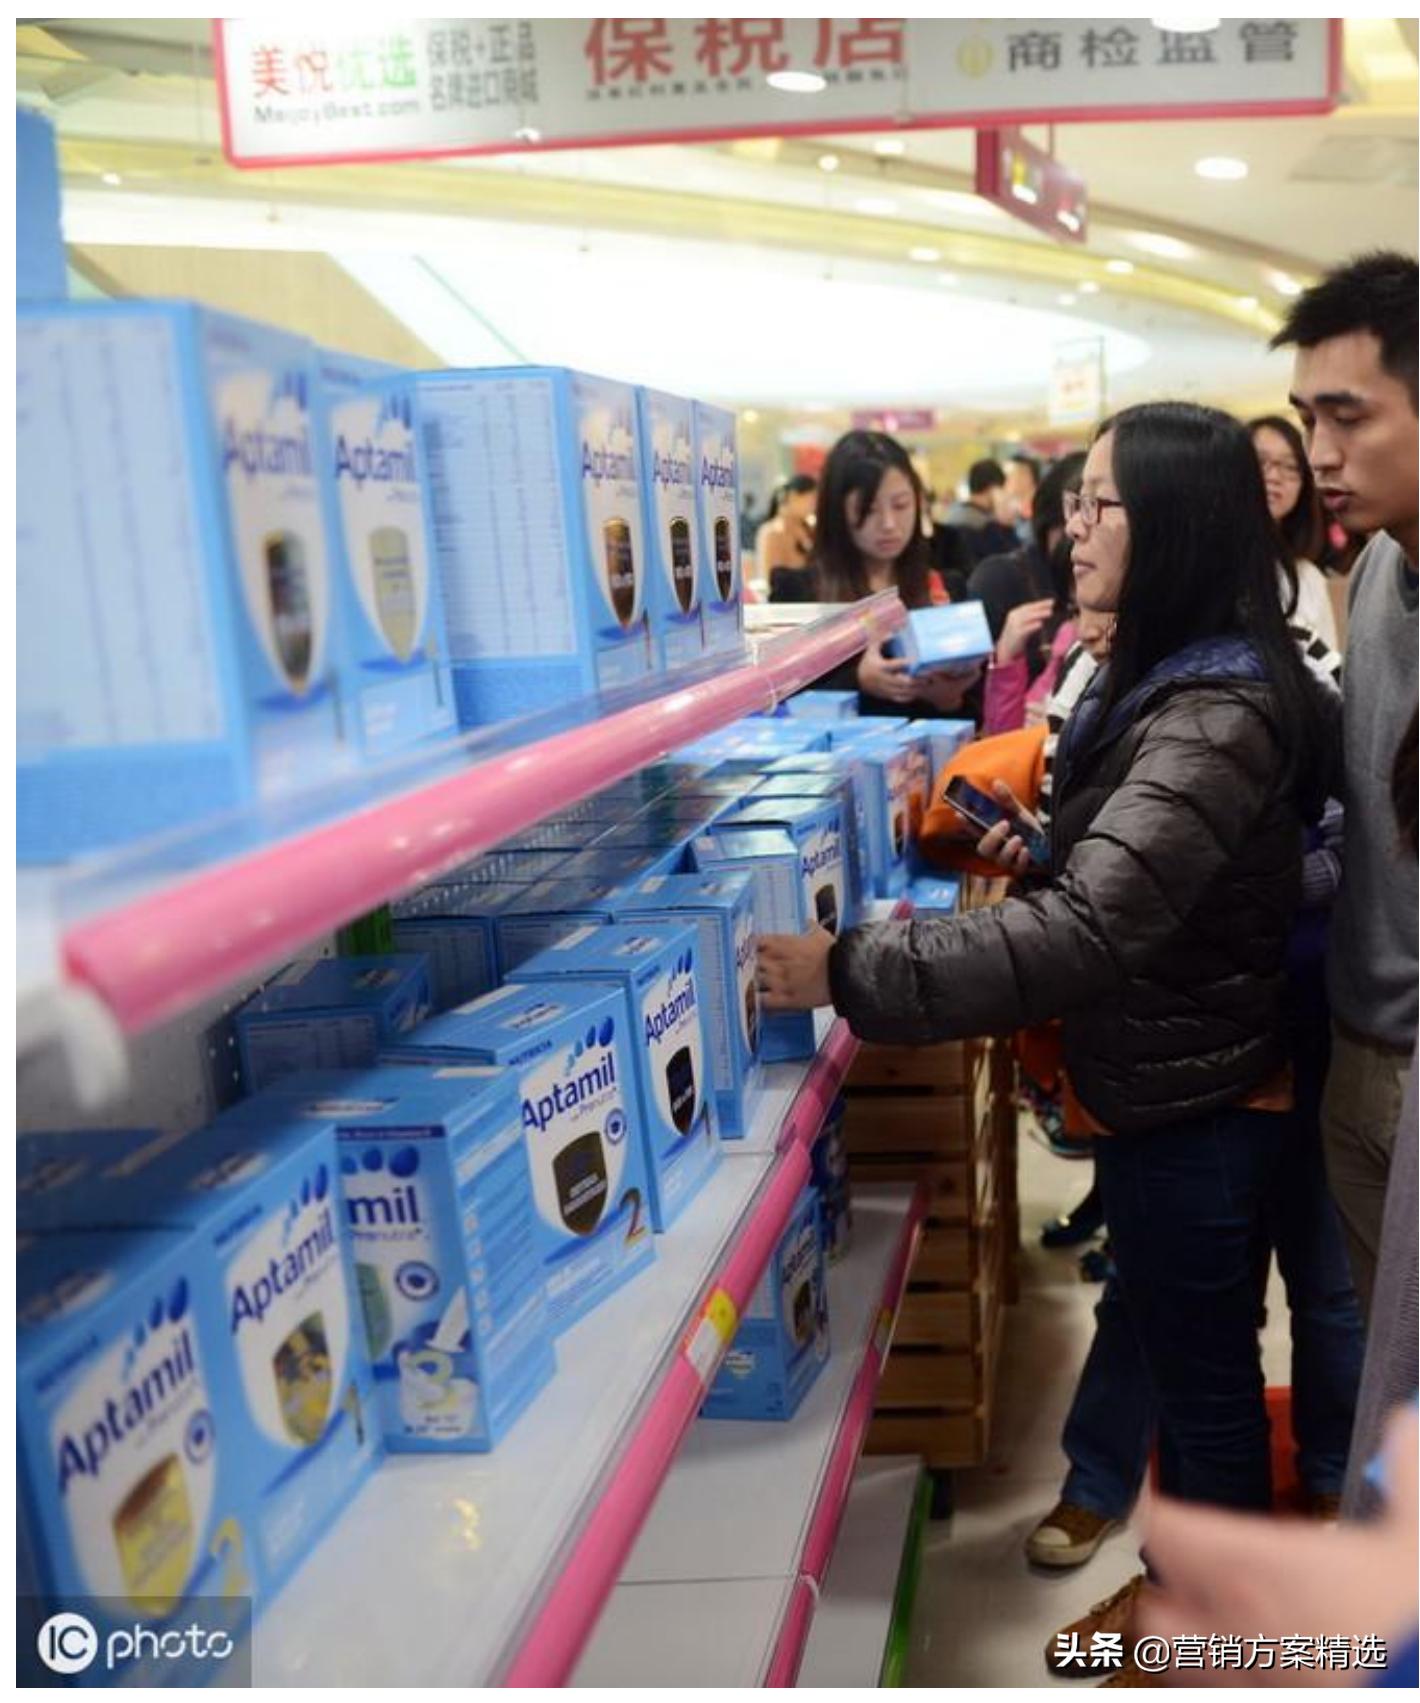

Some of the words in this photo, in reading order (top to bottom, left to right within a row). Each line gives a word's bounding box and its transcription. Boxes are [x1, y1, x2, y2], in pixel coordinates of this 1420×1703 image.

[645, 976, 696, 1047] Aptamil
[521, 1051, 616, 1132] Aptamil
[618, 1187, 646, 1246] 2
[230, 1206, 334, 1336] Aptamil
[58, 1329, 194, 1496] Aptamil
